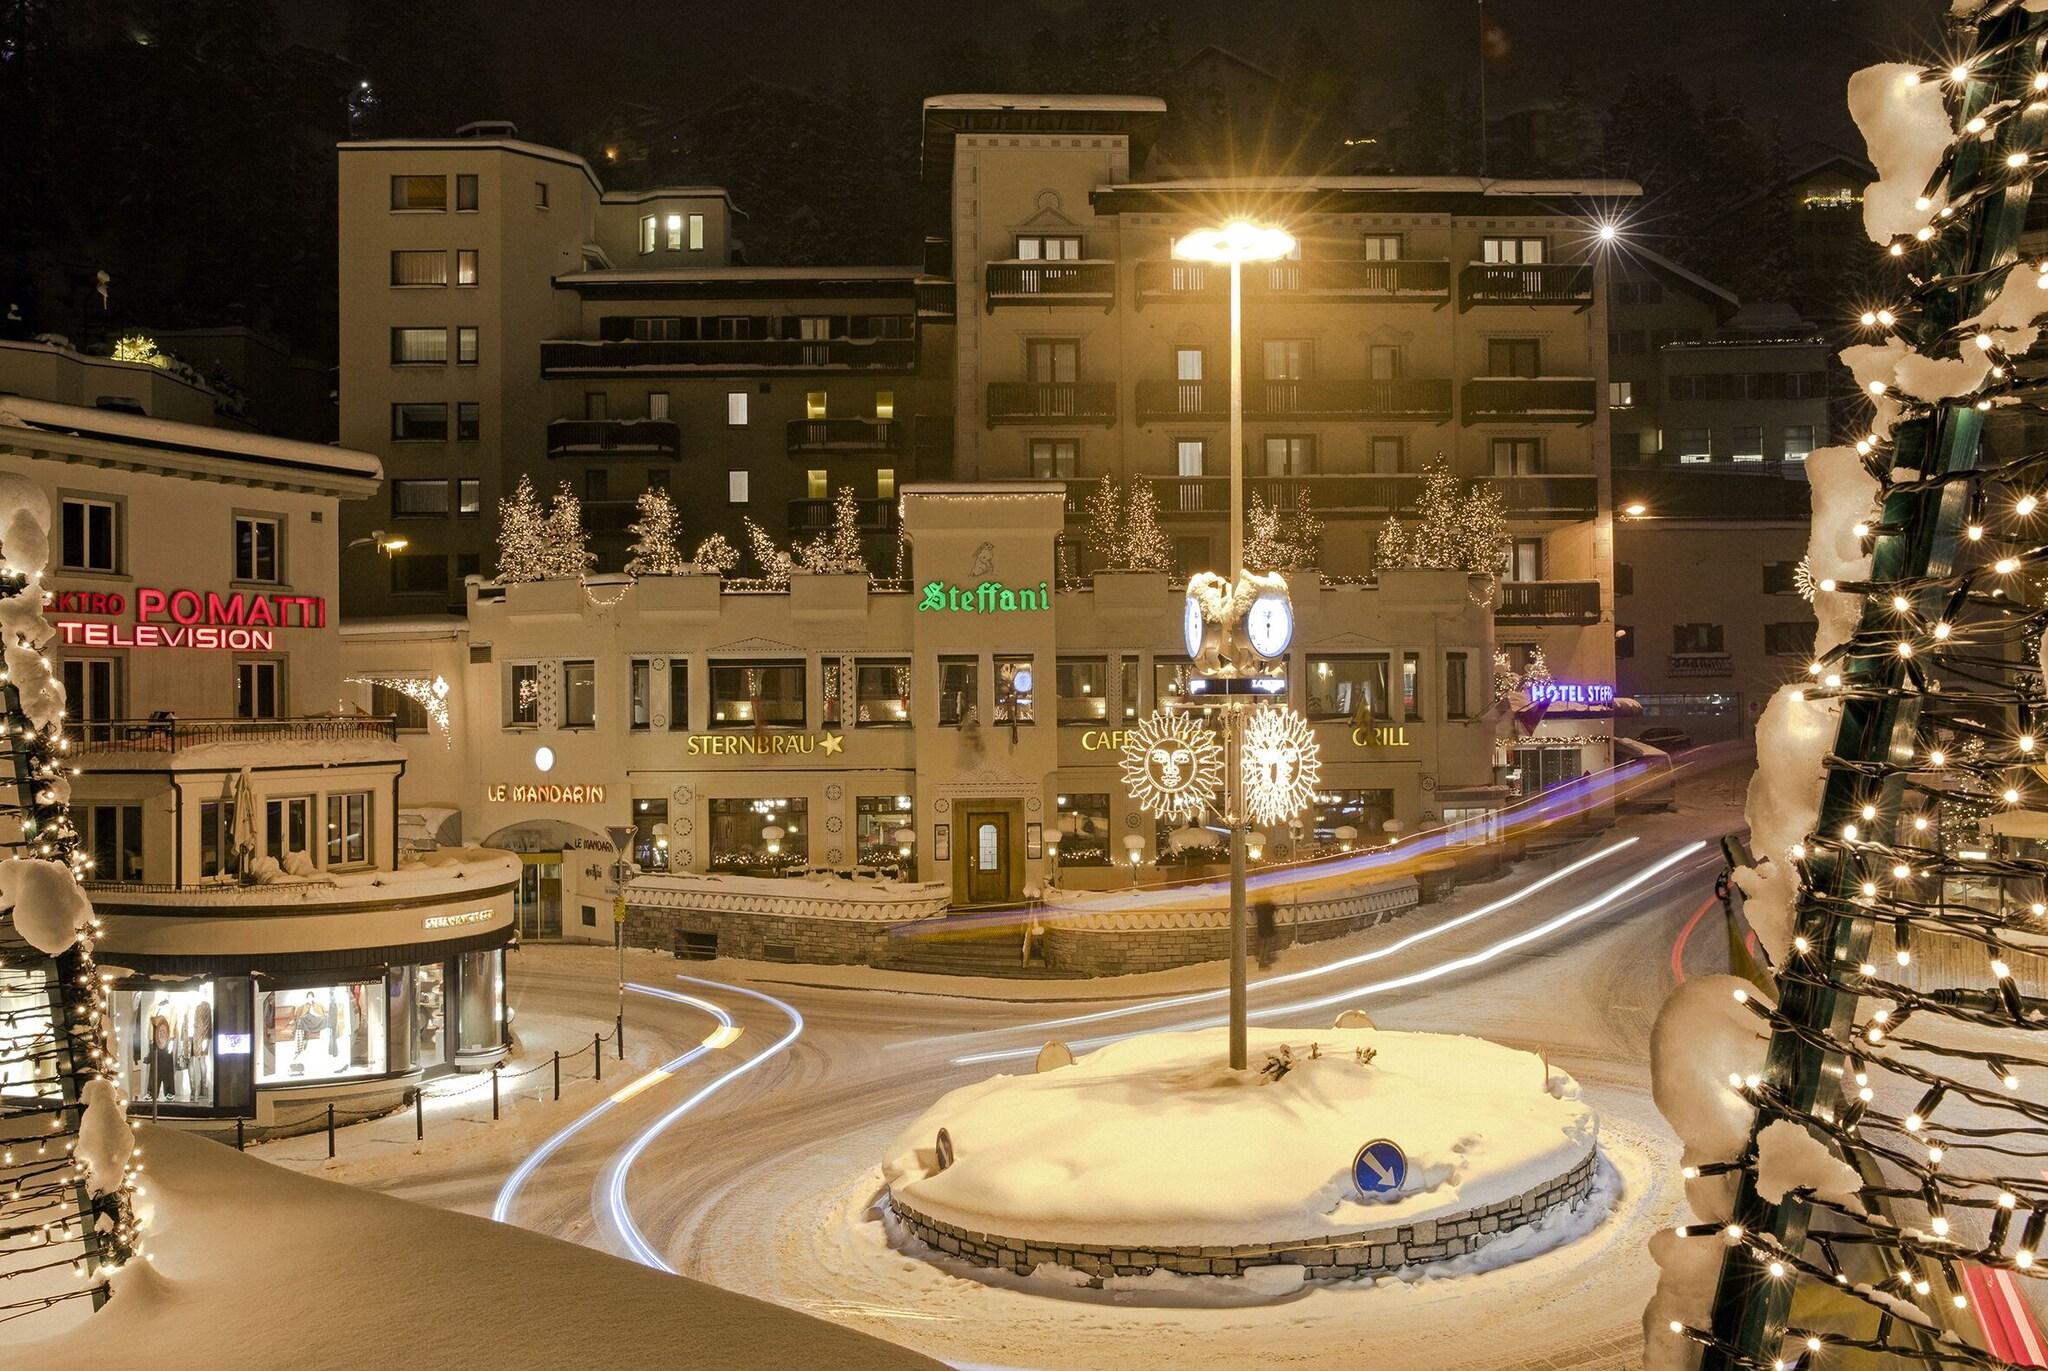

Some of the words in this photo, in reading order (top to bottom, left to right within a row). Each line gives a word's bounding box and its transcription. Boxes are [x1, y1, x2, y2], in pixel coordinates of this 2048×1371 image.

[43, 591, 126, 616] KTRO
[136, 587, 326, 628] POMATTI
[918, 581, 1050, 614] Steffani
[57, 622, 273, 650] TELEVISION
[1531, 684, 1584, 702] HOTEL
[687, 735, 815, 755] STERNBRÄU
[488, 785, 506, 802] LE
[513, 785, 604, 803] MANDARIN
